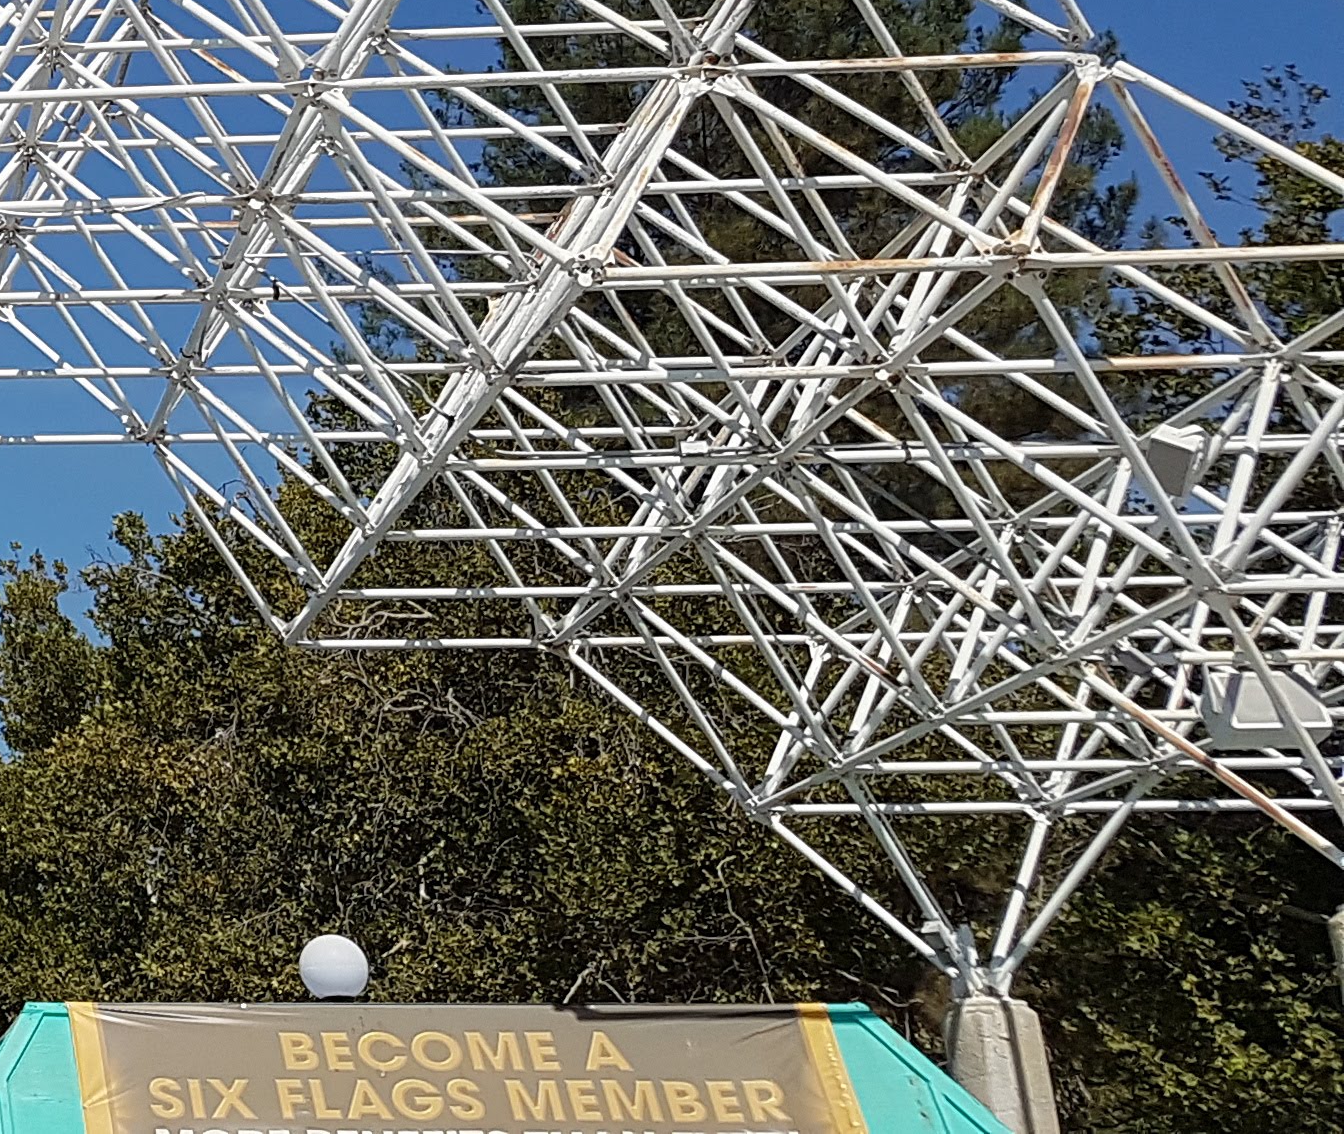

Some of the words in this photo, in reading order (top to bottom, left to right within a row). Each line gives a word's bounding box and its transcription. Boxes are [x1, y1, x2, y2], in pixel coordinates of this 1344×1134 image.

[278, 1030, 563, 1073] BECOME
[584, 1029, 635, 1072] A
[149, 1077, 261, 1121] SIX
[278, 1077, 486, 1121] FLAGS
[505, 1078, 791, 1122] MEMBER
